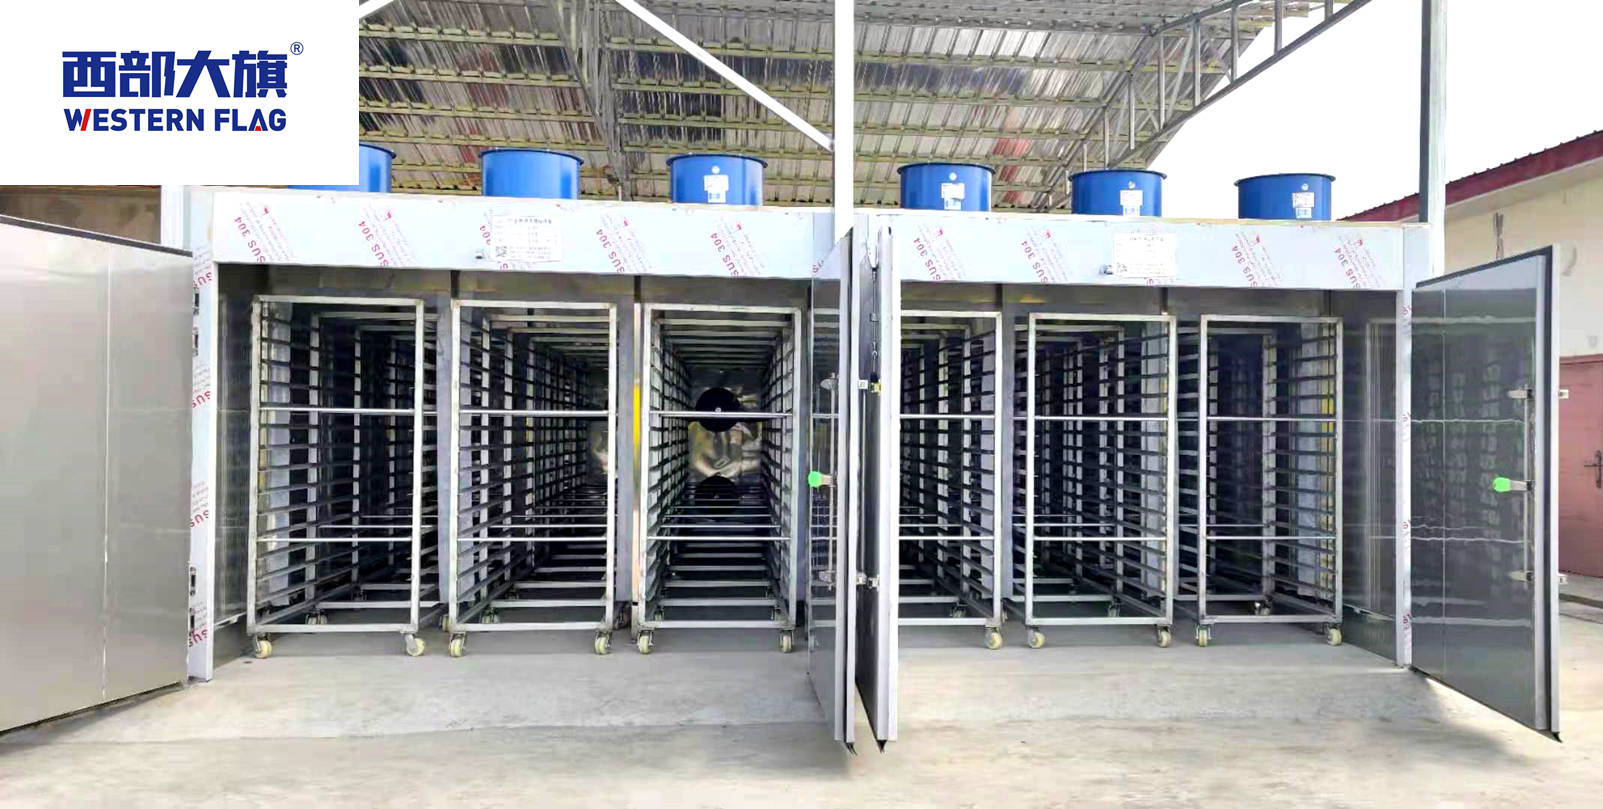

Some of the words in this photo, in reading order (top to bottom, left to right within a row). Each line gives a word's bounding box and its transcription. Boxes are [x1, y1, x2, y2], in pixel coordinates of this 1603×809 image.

[234, 216, 251, 237] 304
[358, 221, 374, 241] 304
[596, 229, 612, 248] 304
[710, 233, 725, 252] 304
[913, 237, 928, 256] 304
[248, 240, 266, 264] SUS
[371, 244, 389, 267] SUS
[1021, 240, 1036, 260] 304
[1231, 245, 1245, 264] 304
[1334, 247, 1348, 267] 304
[608, 251, 625, 275] SUS
[722, 255, 739, 276] SUS
[925, 259, 942, 281] SUS
[1032, 262, 1049, 284] SUS
[1243, 266, 1258, 288] SUS
[1345, 268, 1360, 288] SUS
